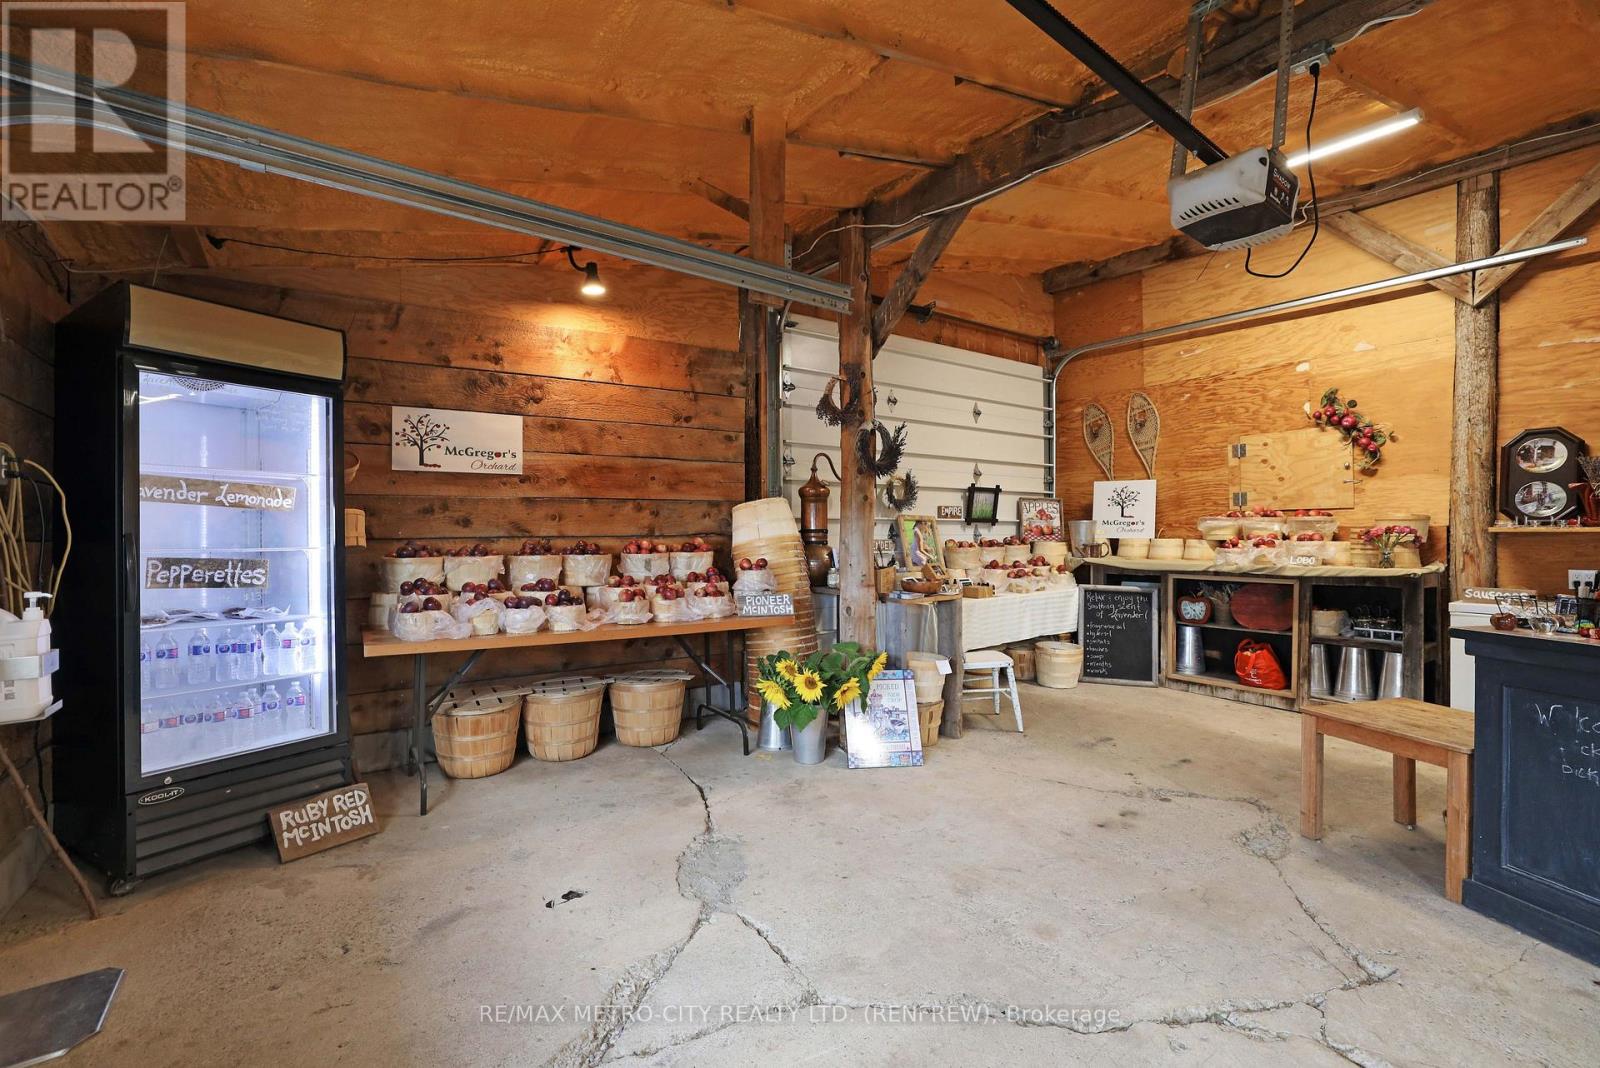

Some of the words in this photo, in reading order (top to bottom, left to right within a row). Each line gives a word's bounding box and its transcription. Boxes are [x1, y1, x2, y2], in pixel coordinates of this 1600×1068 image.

[444, 446, 517, 460] McGregor's
[470, 460, 516, 471] Orchard
[139, 479, 208, 503] avender
[215, 483, 293, 508] Lemonade
[941, 506, 961, 516] EMPIRE
[1102, 519, 1145, 527] McGregor's
[1290, 555, 1316, 565] LOBO
[745, 594, 790, 605] PIONEER
[280, 798, 329, 830] RUBY
[333, 789, 368, 813] RED
